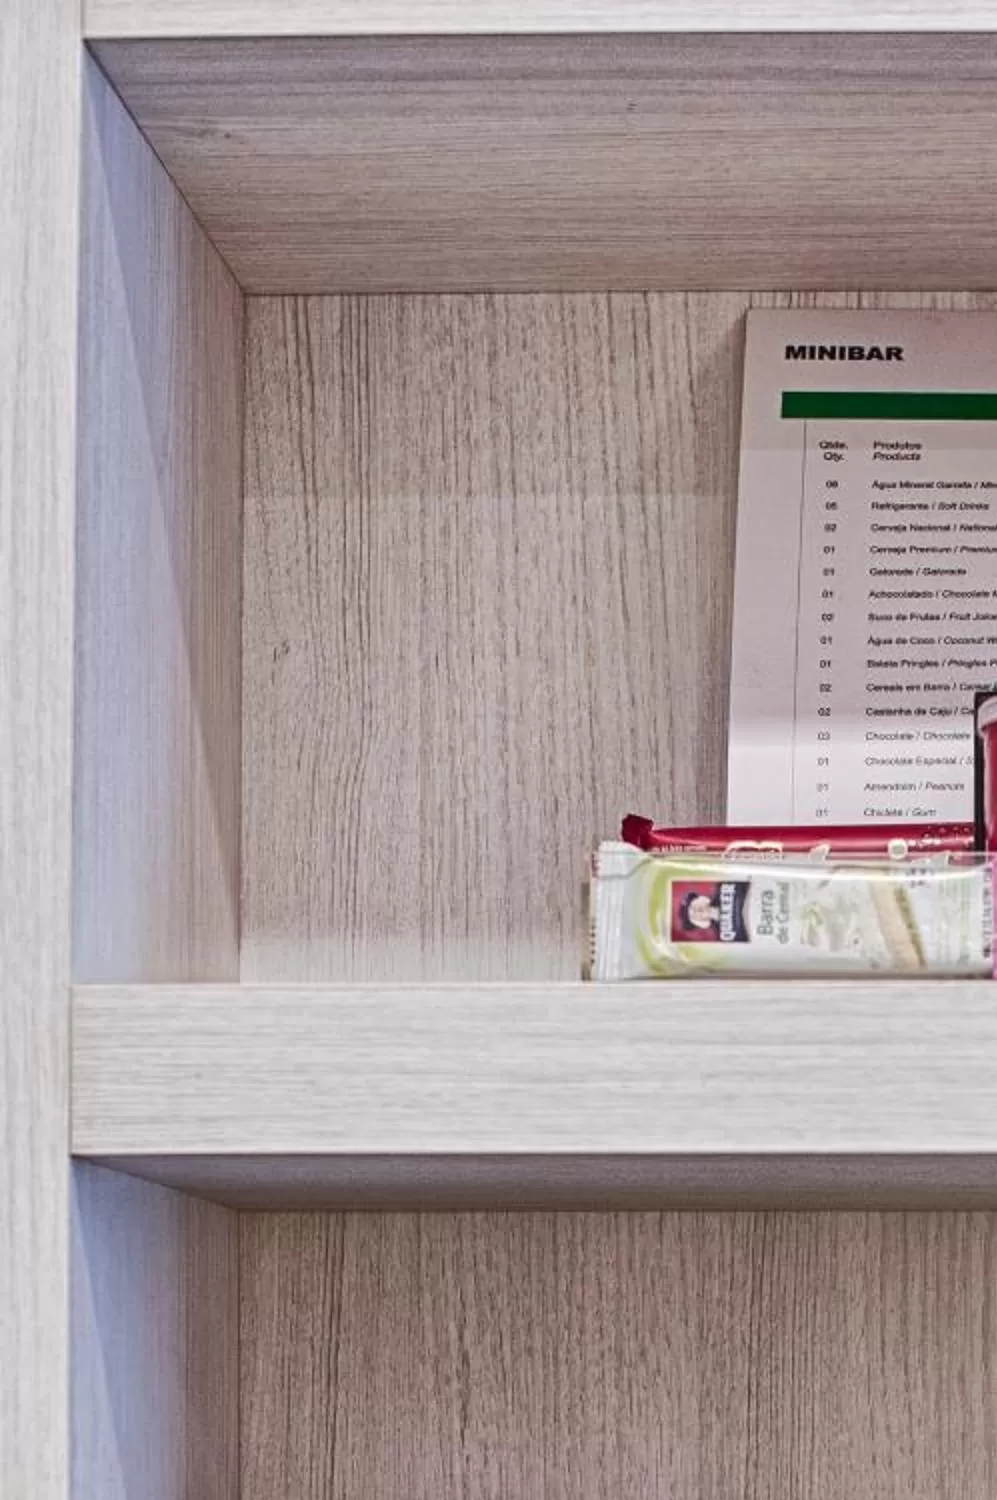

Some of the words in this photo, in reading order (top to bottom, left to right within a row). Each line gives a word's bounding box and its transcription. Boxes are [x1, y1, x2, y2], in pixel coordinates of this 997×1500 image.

[784, 345, 904, 361] MINIBAR
[873, 441, 922, 451] Produtos
[823, 452, 845, 463] Qty.
[872, 452, 921, 461] Products
[817, 757, 829, 766] 01
[720, 883, 736, 941] QUAKER
[757, 889, 775, 936] Barra
